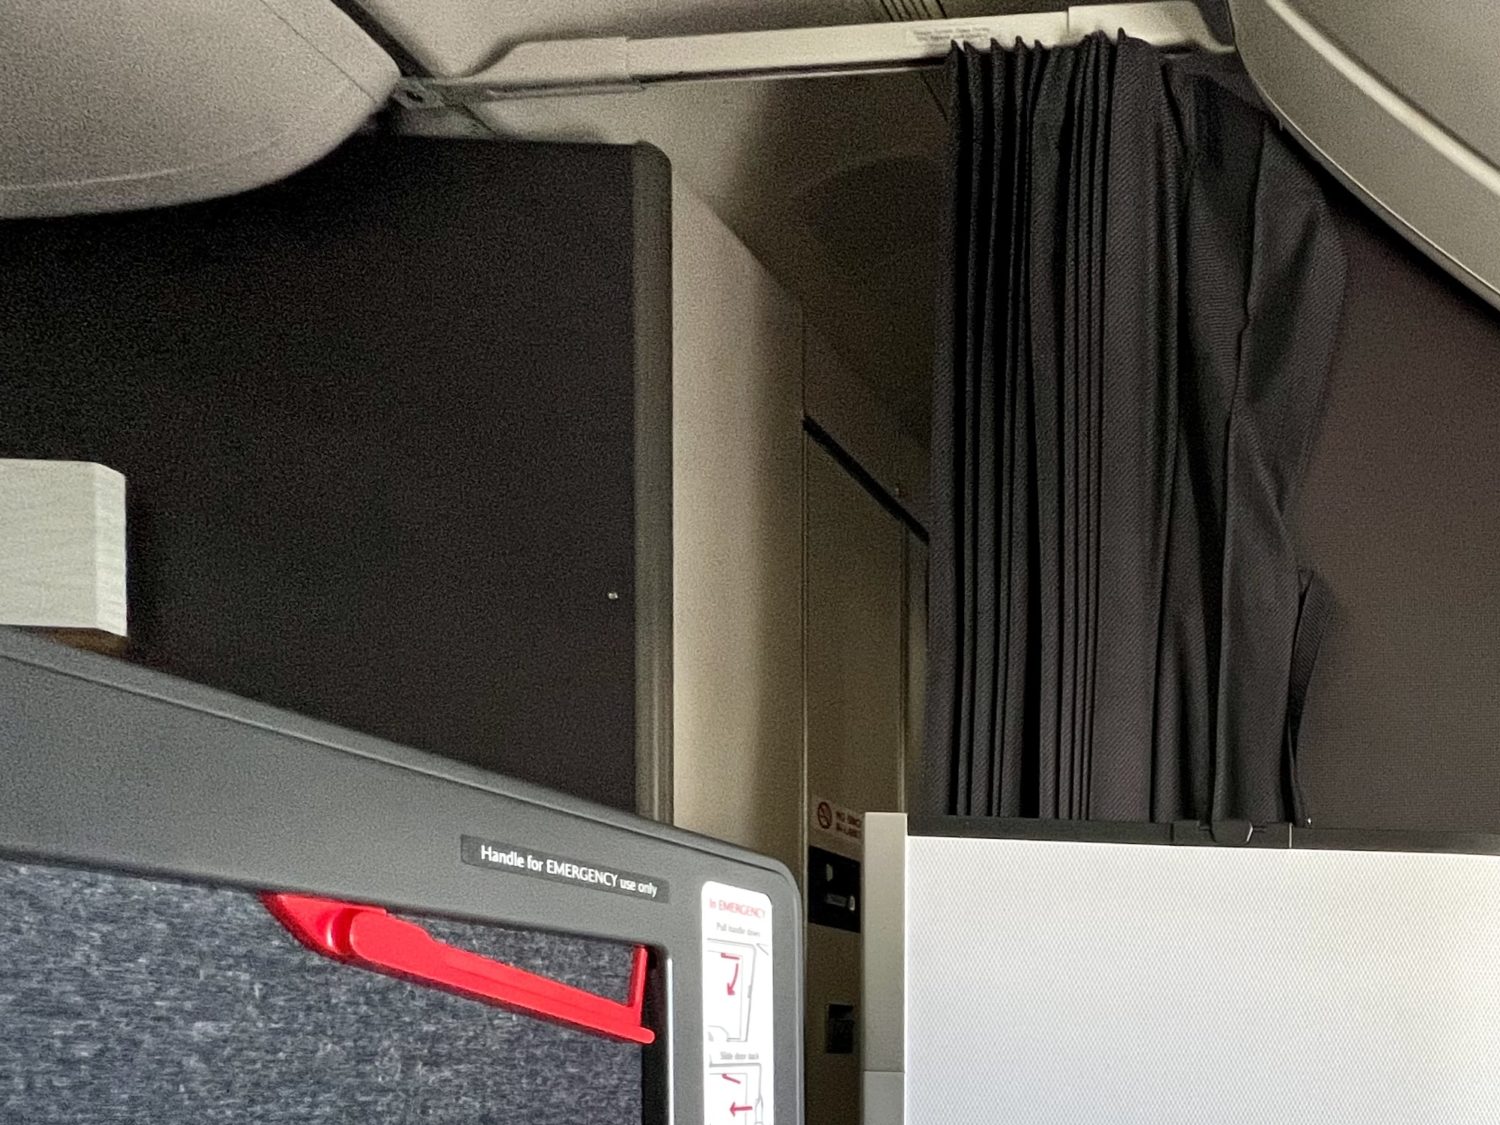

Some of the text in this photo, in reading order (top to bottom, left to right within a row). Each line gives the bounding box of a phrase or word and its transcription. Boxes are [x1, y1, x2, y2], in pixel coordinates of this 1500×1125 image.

[481, 844, 658, 898] Handle for EMERGENCY use only
